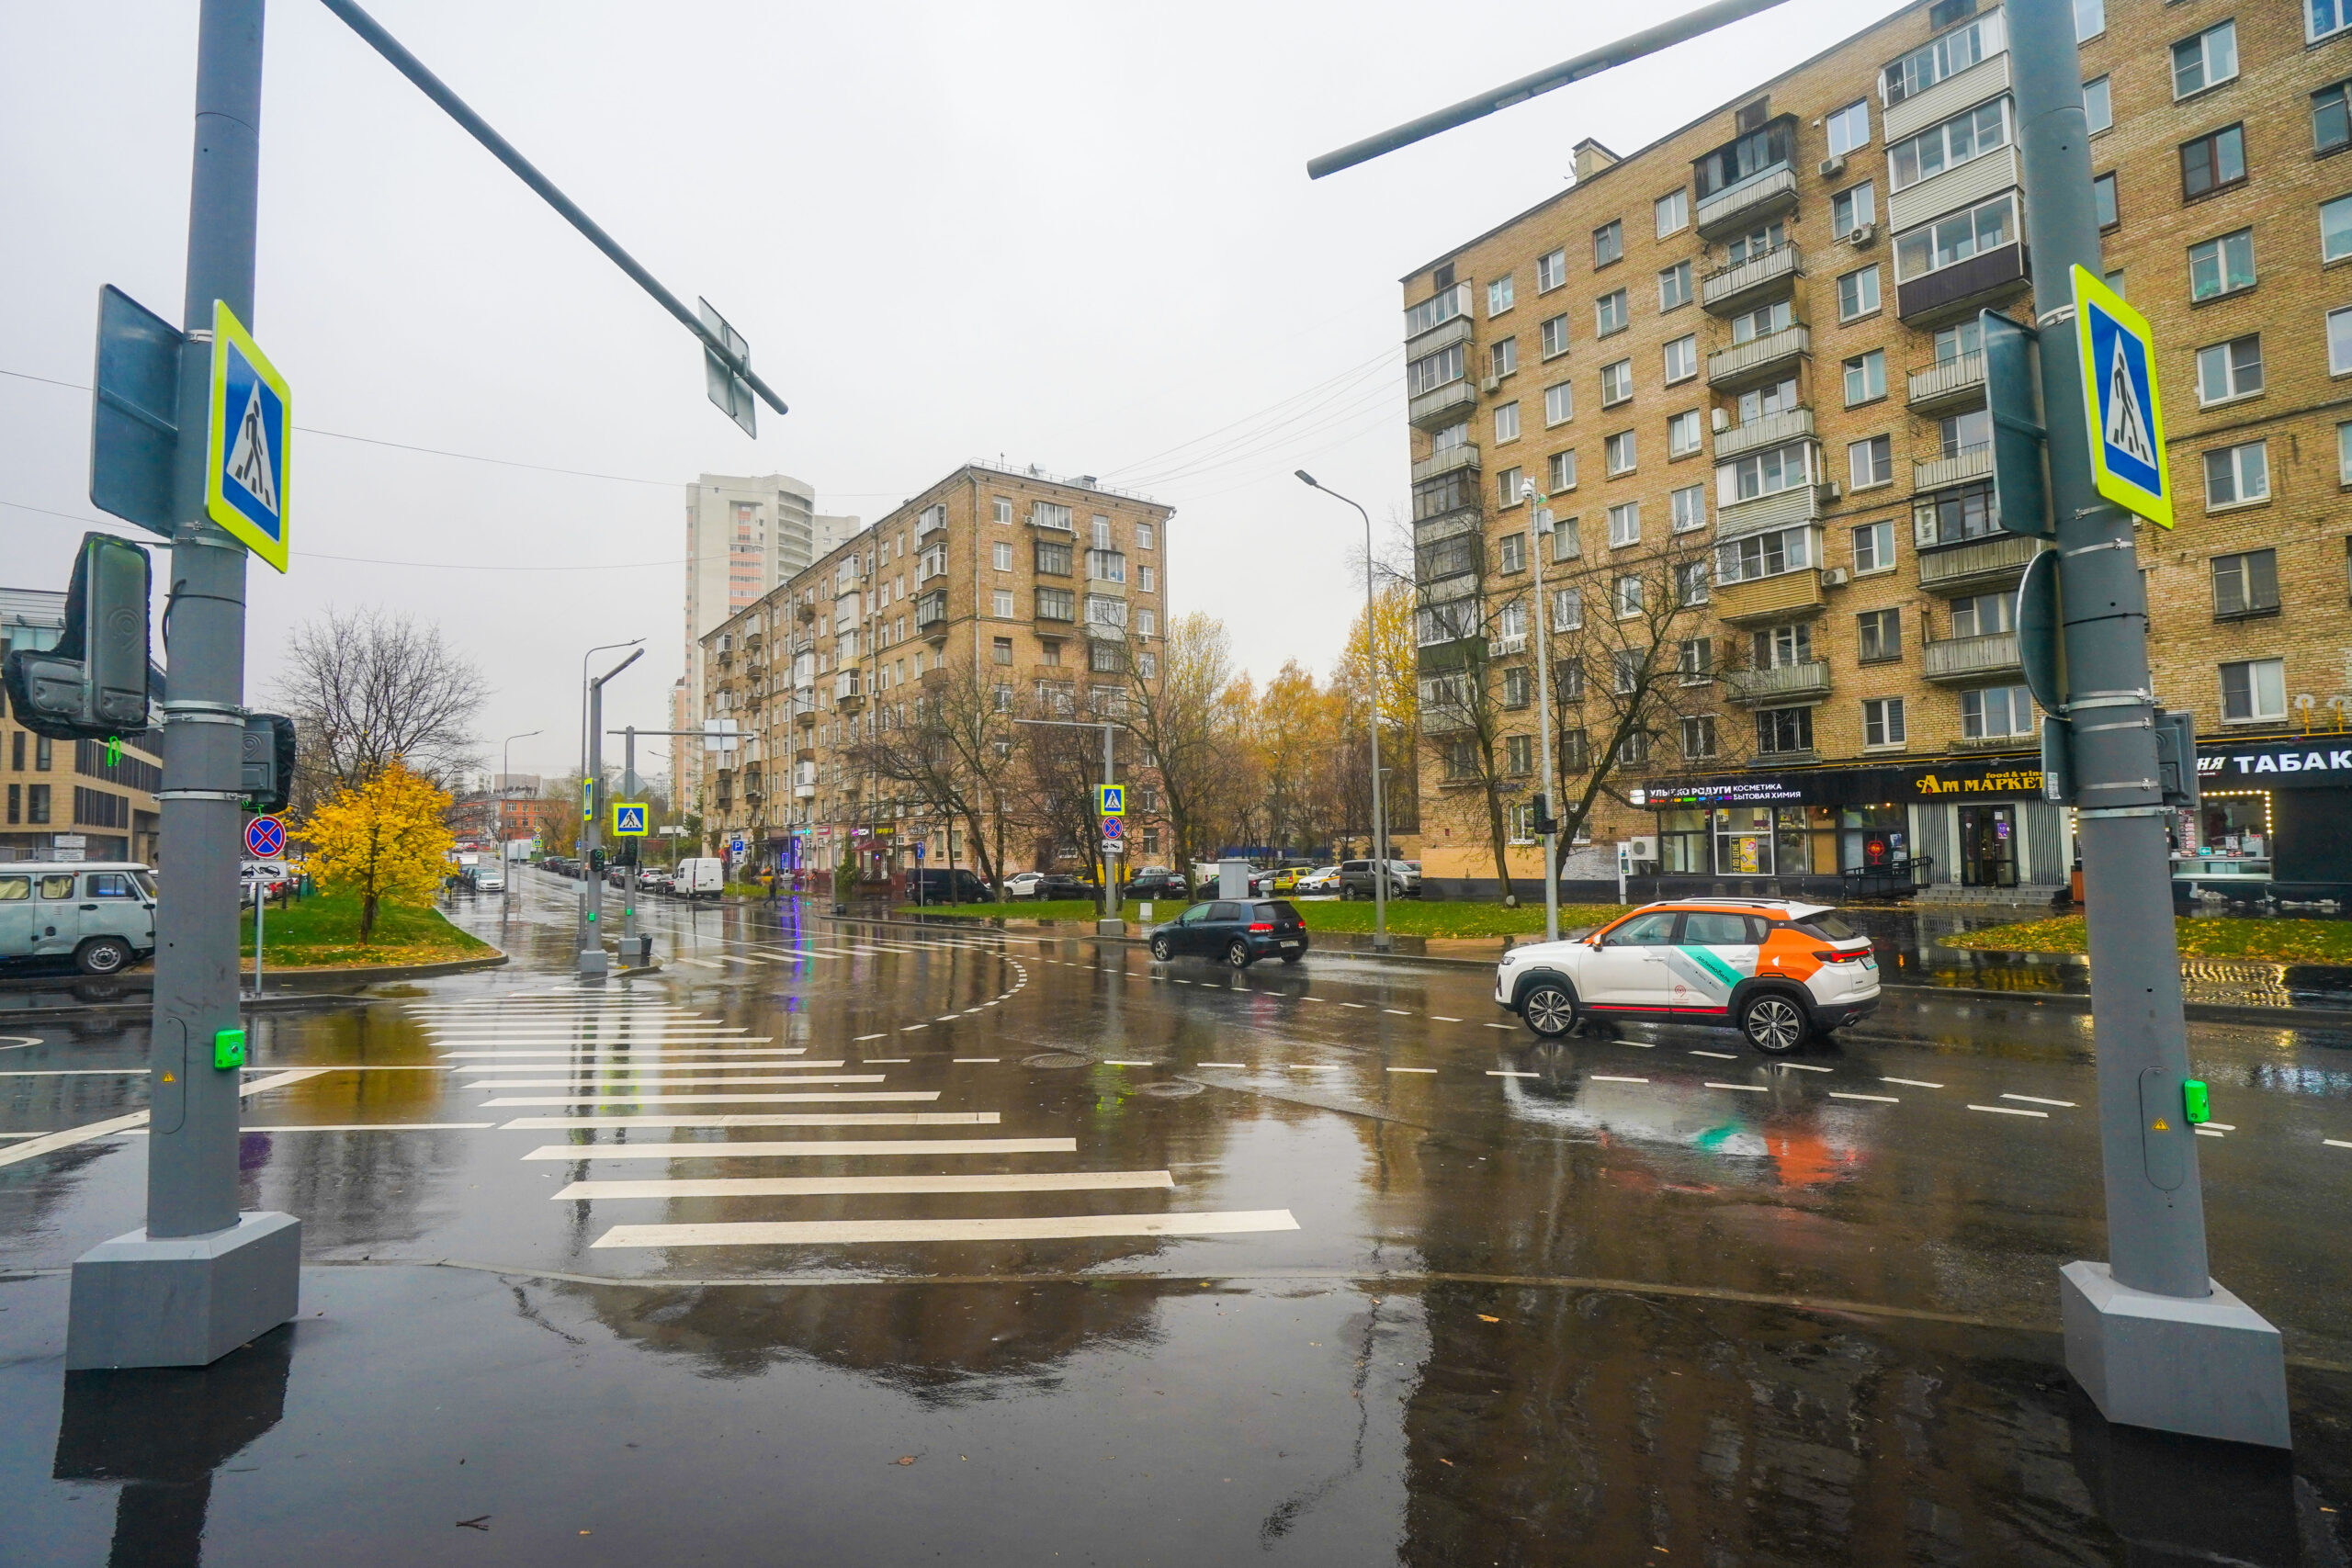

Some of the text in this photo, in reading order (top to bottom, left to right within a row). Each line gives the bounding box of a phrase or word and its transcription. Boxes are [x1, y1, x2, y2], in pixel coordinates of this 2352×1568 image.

[2233, 750, 2352, 774] ТАБАК
[1733, 784, 1781, 792] КОСМЕТИКА
[1964, 776, 2043, 792] МАРКЕТ
[1733, 791, 1802, 800] БЫТОВАЯ ХИМИЯ
